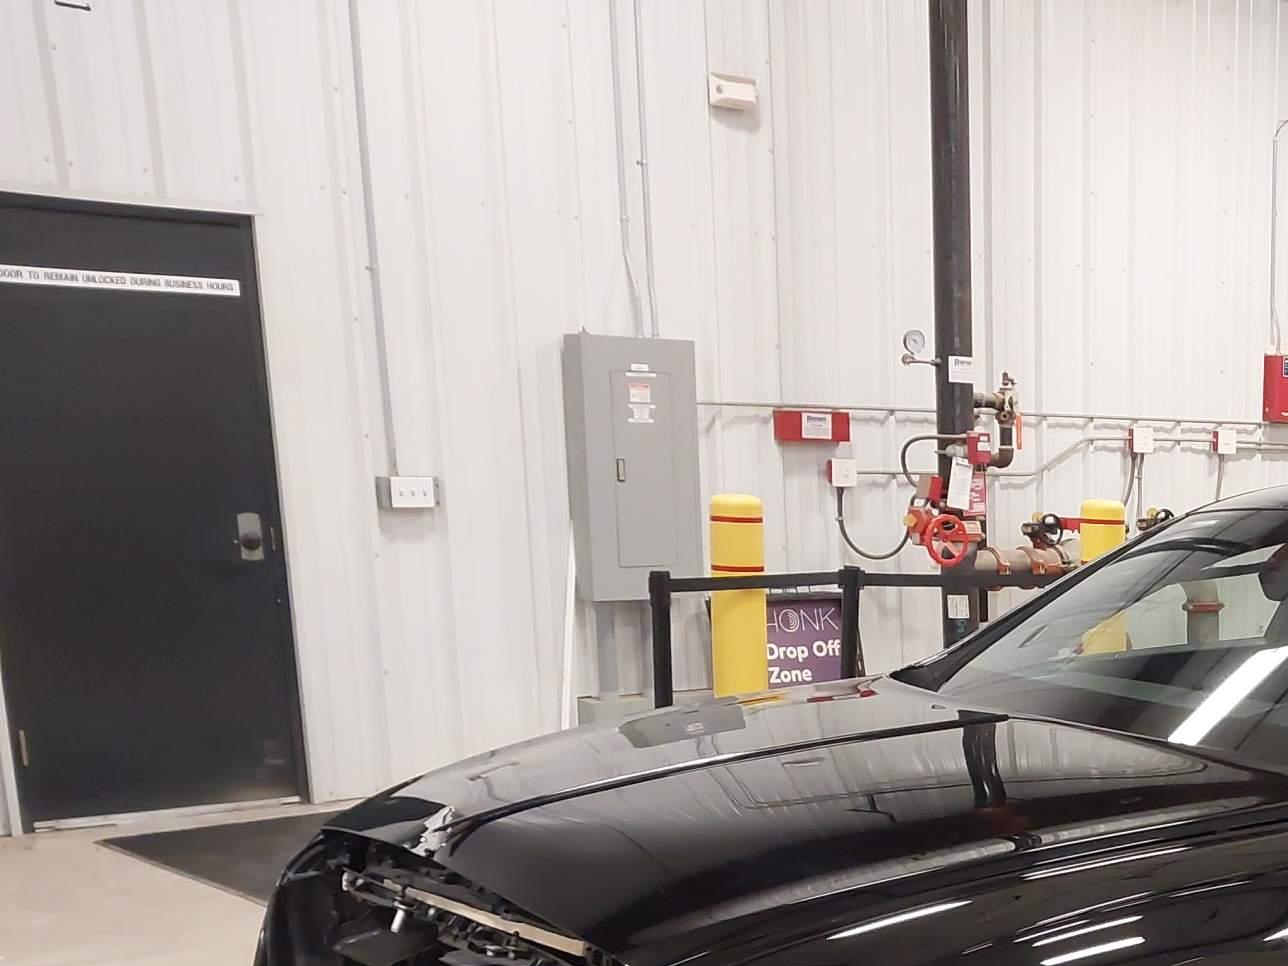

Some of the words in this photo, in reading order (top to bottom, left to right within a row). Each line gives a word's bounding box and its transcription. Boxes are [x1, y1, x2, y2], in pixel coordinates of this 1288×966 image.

[28, 271, 40, 280] TO
[44, 271, 78, 282] REMAIN
[82, 273, 127, 285] UNLOCKED
[130, 276, 161, 286] DURING
[165, 279, 203, 289] BUSINESS
[207, 280, 234, 291] HOURS
[766, 643, 809, 663] Drop
[812, 638, 841, 657] Off
[768, 666, 812, 684] Zone
